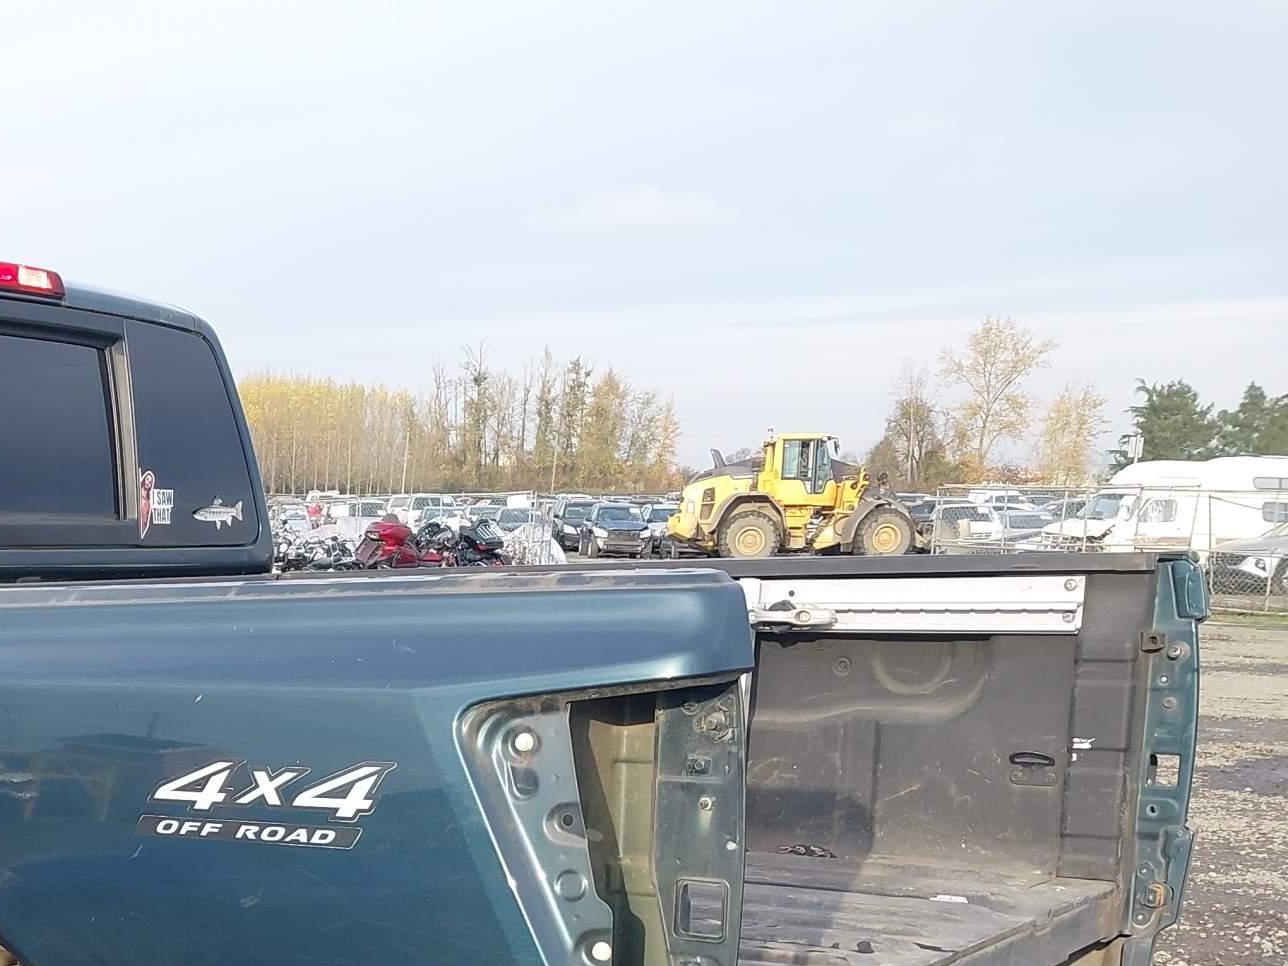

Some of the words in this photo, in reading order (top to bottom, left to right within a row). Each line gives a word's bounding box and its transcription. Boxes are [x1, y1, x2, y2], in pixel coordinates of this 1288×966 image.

[156, 490, 173, 506] SAW
[152, 507, 170, 523] THAT
[156, 819, 222, 836] OFF
[235, 825, 336, 844] ROAD
